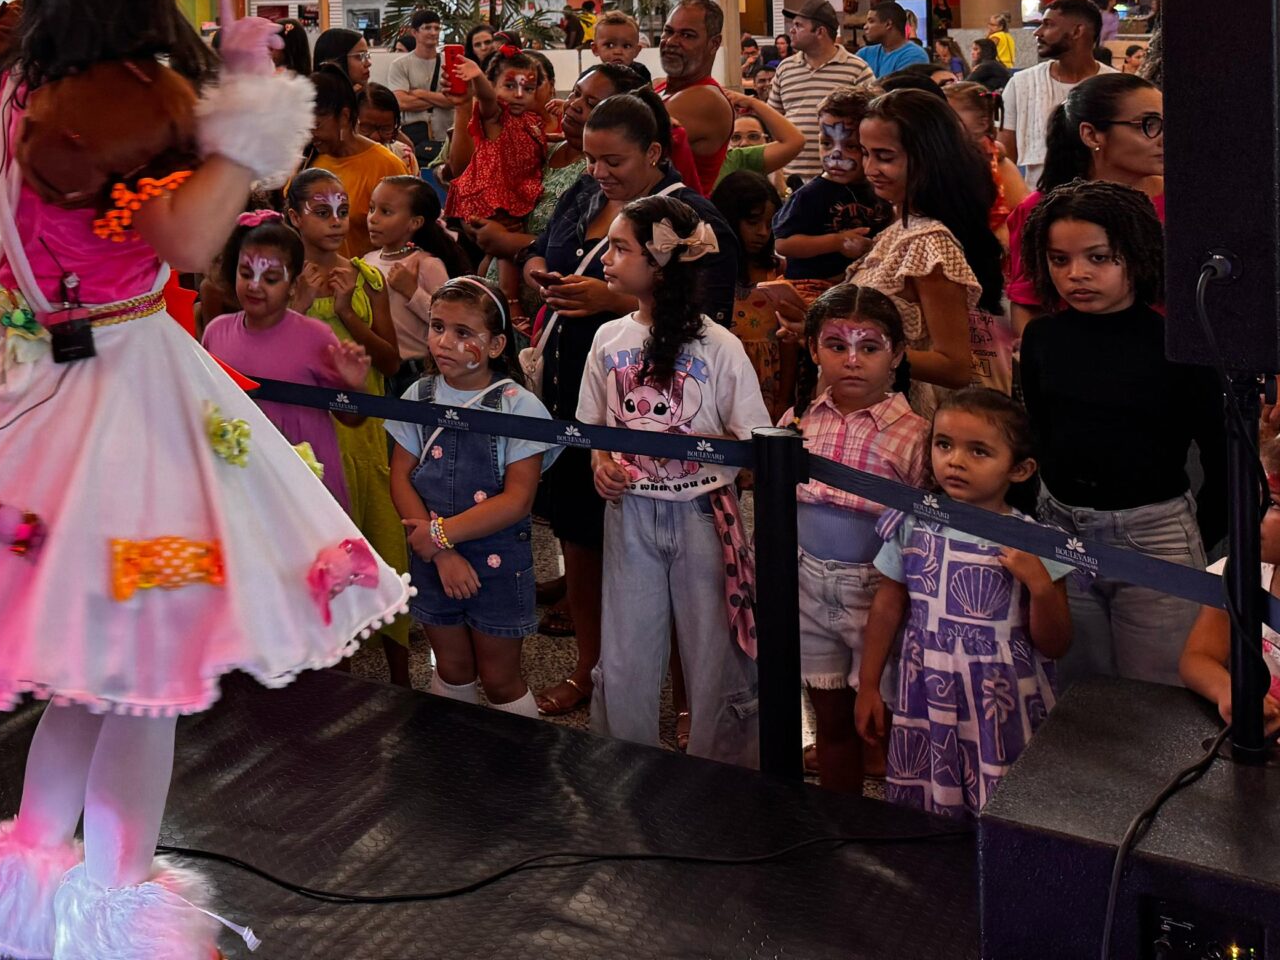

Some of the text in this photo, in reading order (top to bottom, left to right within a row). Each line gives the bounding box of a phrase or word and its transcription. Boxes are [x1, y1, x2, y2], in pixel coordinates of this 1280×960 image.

[686, 450, 725, 461] BOULEVARD
[673, 480, 699, 493] you
[701, 475, 718, 486] do
[1055, 546, 1098, 566] BOULEVARD
